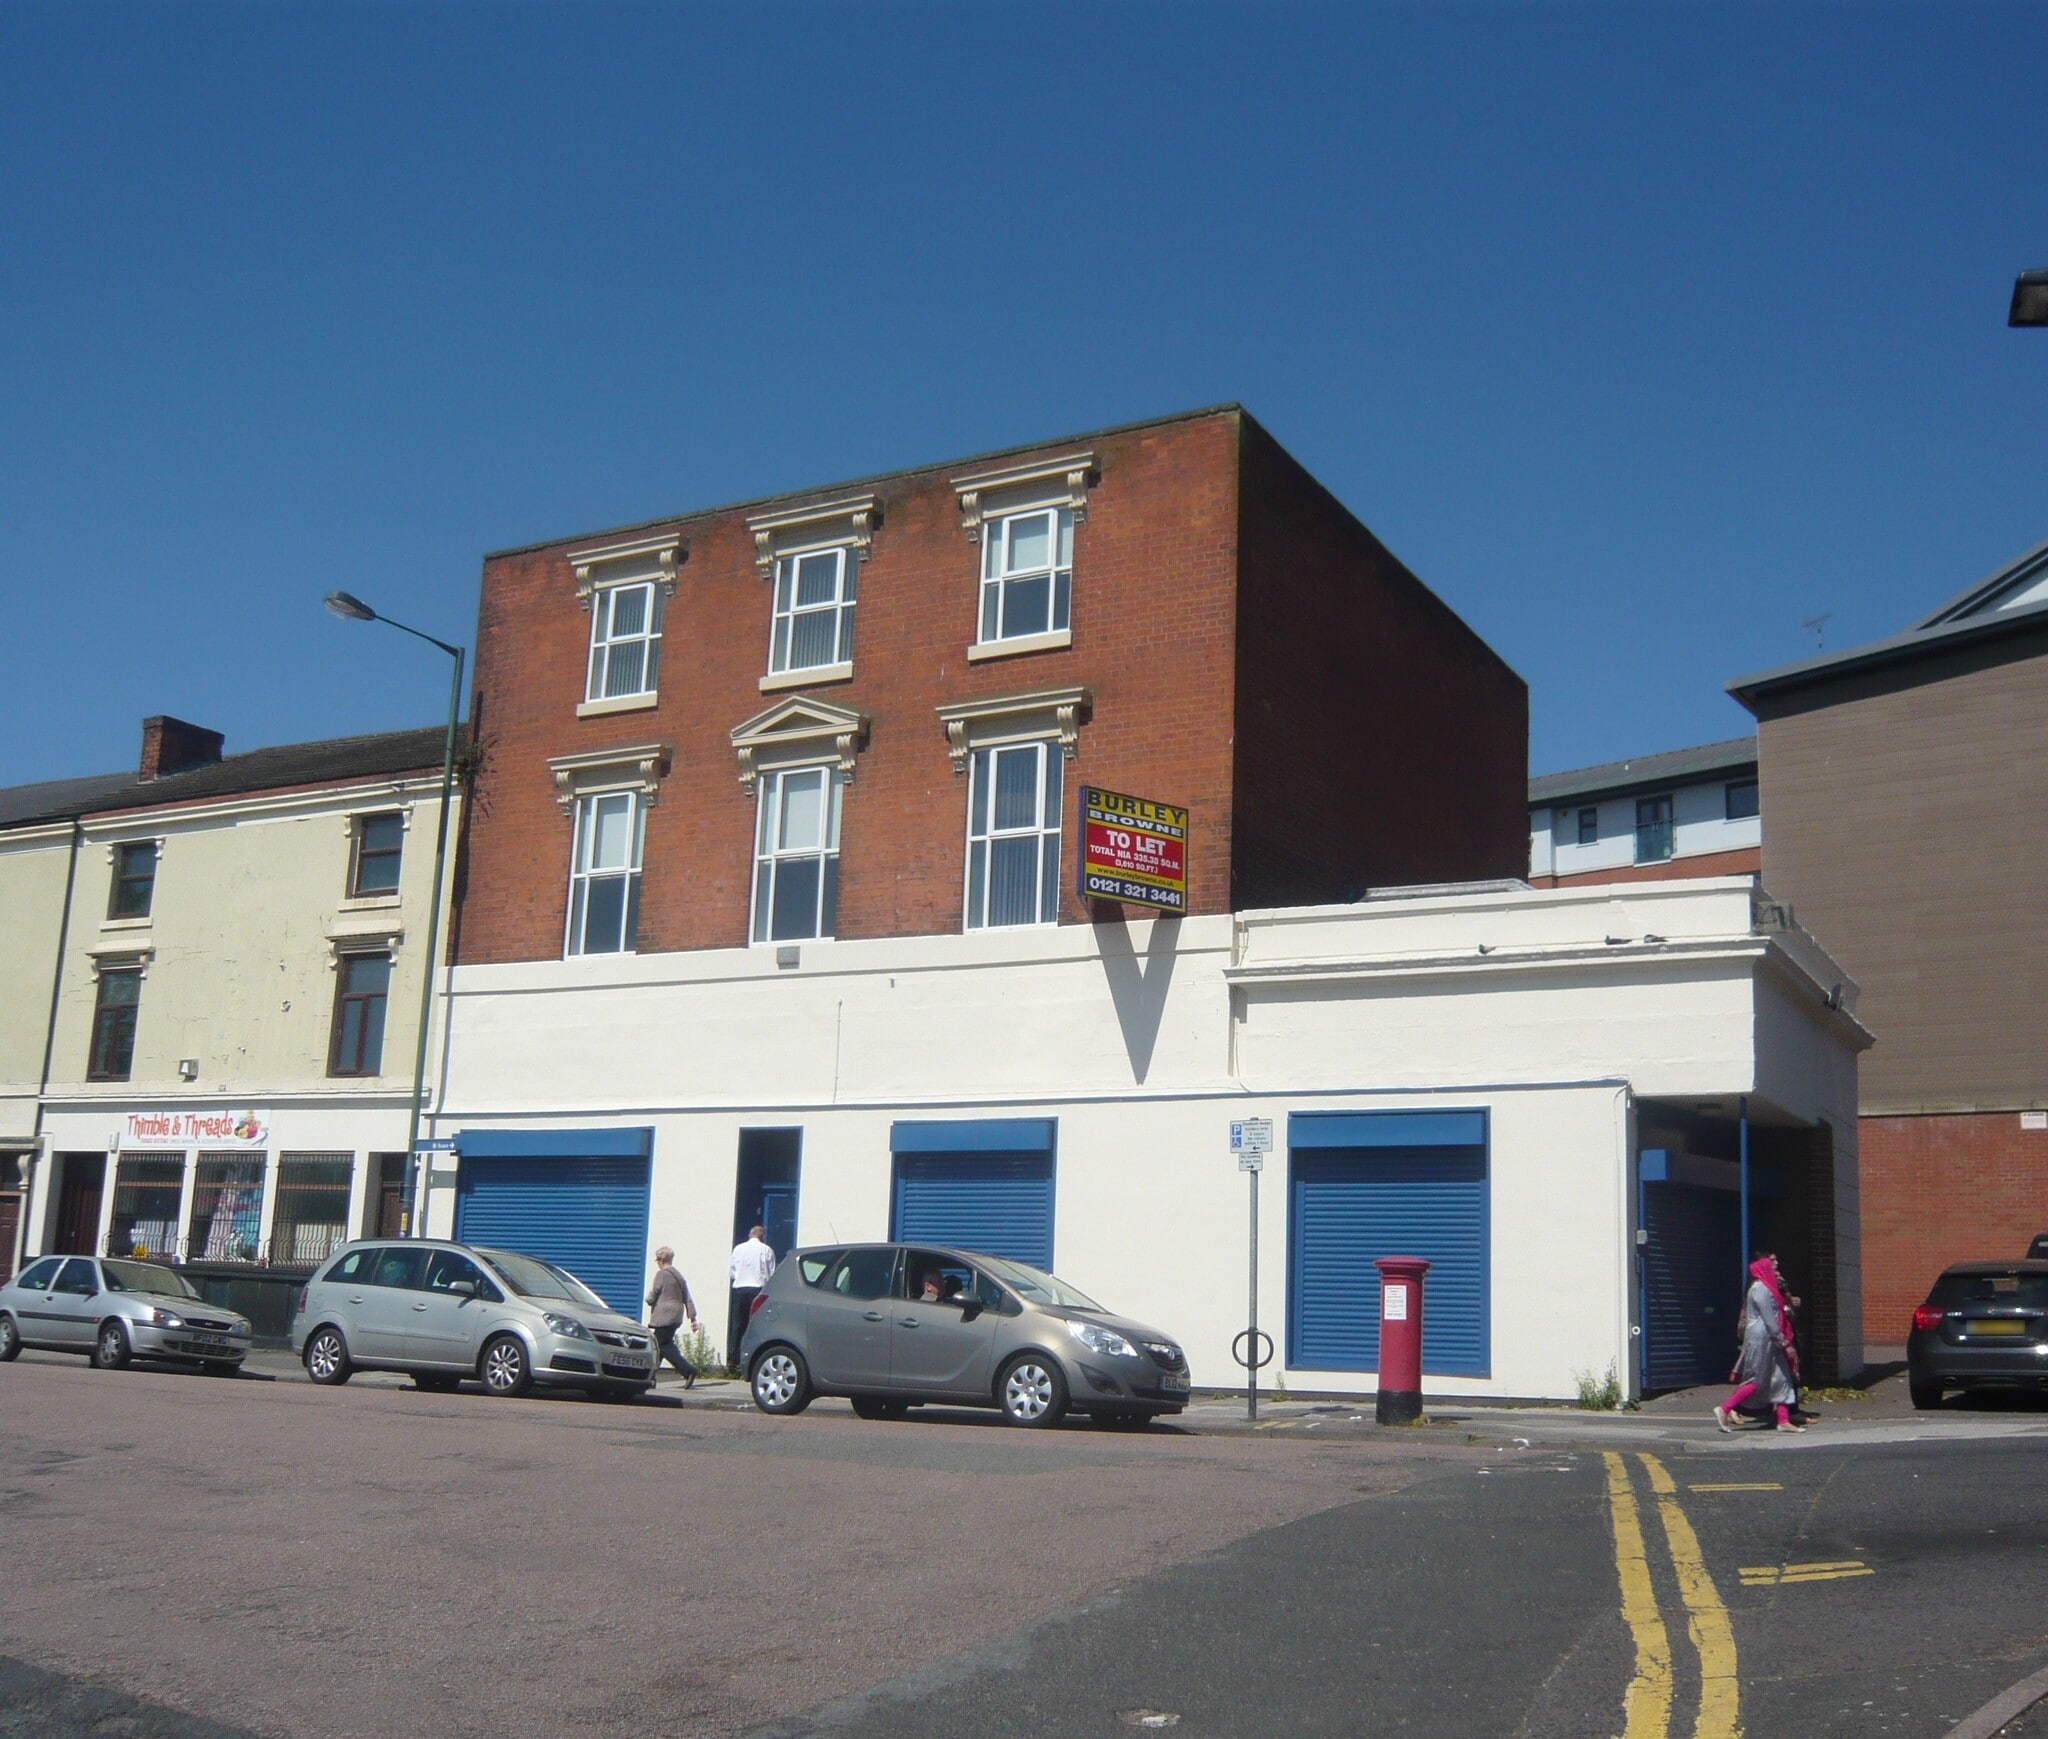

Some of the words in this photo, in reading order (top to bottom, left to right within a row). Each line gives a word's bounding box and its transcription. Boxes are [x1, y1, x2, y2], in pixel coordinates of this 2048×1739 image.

[1087, 790, 1184, 824] BURLEY
[1089, 809, 1182, 837] BROWNE
[1089, 844, 1116, 857] TOTAL
[1117, 850, 1132, 860] NIA
[1106, 829, 1131, 849] TO
[1136, 835, 1167, 856] LET
[1089, 877, 1120, 893] 0121
[1124, 884, 1146, 898] 321
[1150, 889, 1181, 905] 3441
[1096, 867, 1175, 888] www.burleybrowne.co.uk
[127, 1111, 171, 1139] Thimble
[172, 1114, 181, 1136] &
[184, 1110, 234, 1139] Threads
[1234, 1125, 1240, 1135] P
